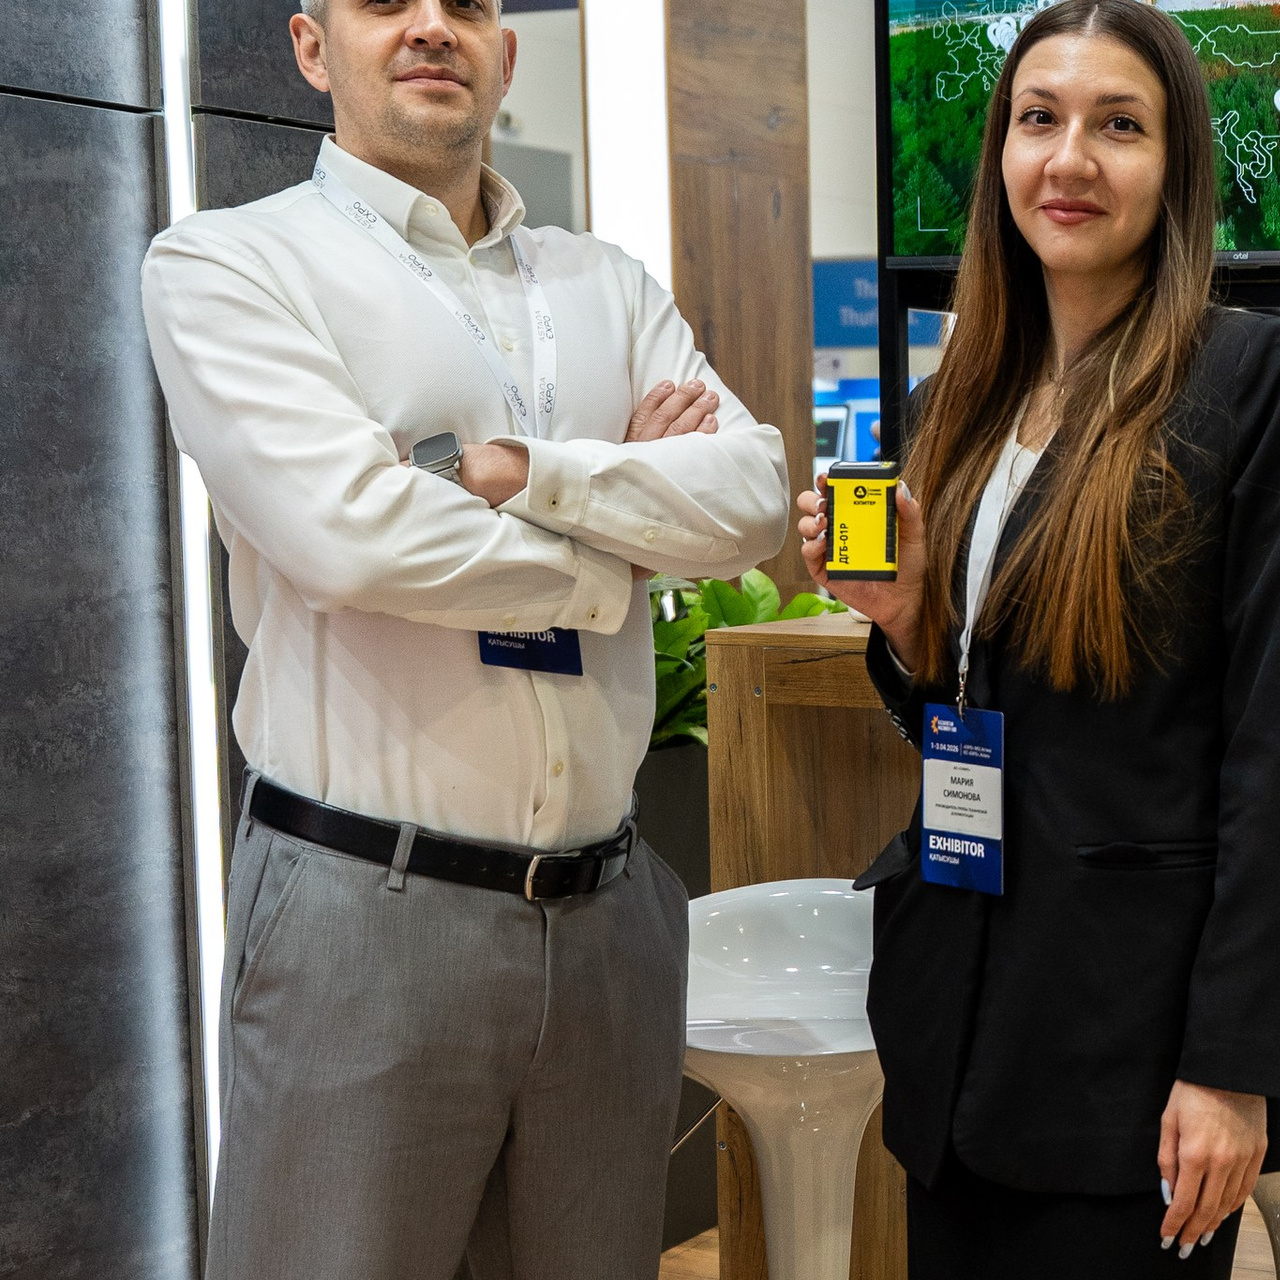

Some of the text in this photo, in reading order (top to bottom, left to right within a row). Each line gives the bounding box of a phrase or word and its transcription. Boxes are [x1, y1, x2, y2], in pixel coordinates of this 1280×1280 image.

[353, 201, 377, 223] EXPO
[408, 254, 432, 277] EXPO
[542, 315, 554, 339] EXPO
[511, 385, 527, 417] EXPO
[544, 382, 555, 413] EXPO
[839, 523, 849, 565] ДГБ-01Р
[950, 775, 975, 787] МАРИЯ
[943, 789, 981, 802] СИМОНОВА
[929, 834, 985, 858] EXHIBITOR
